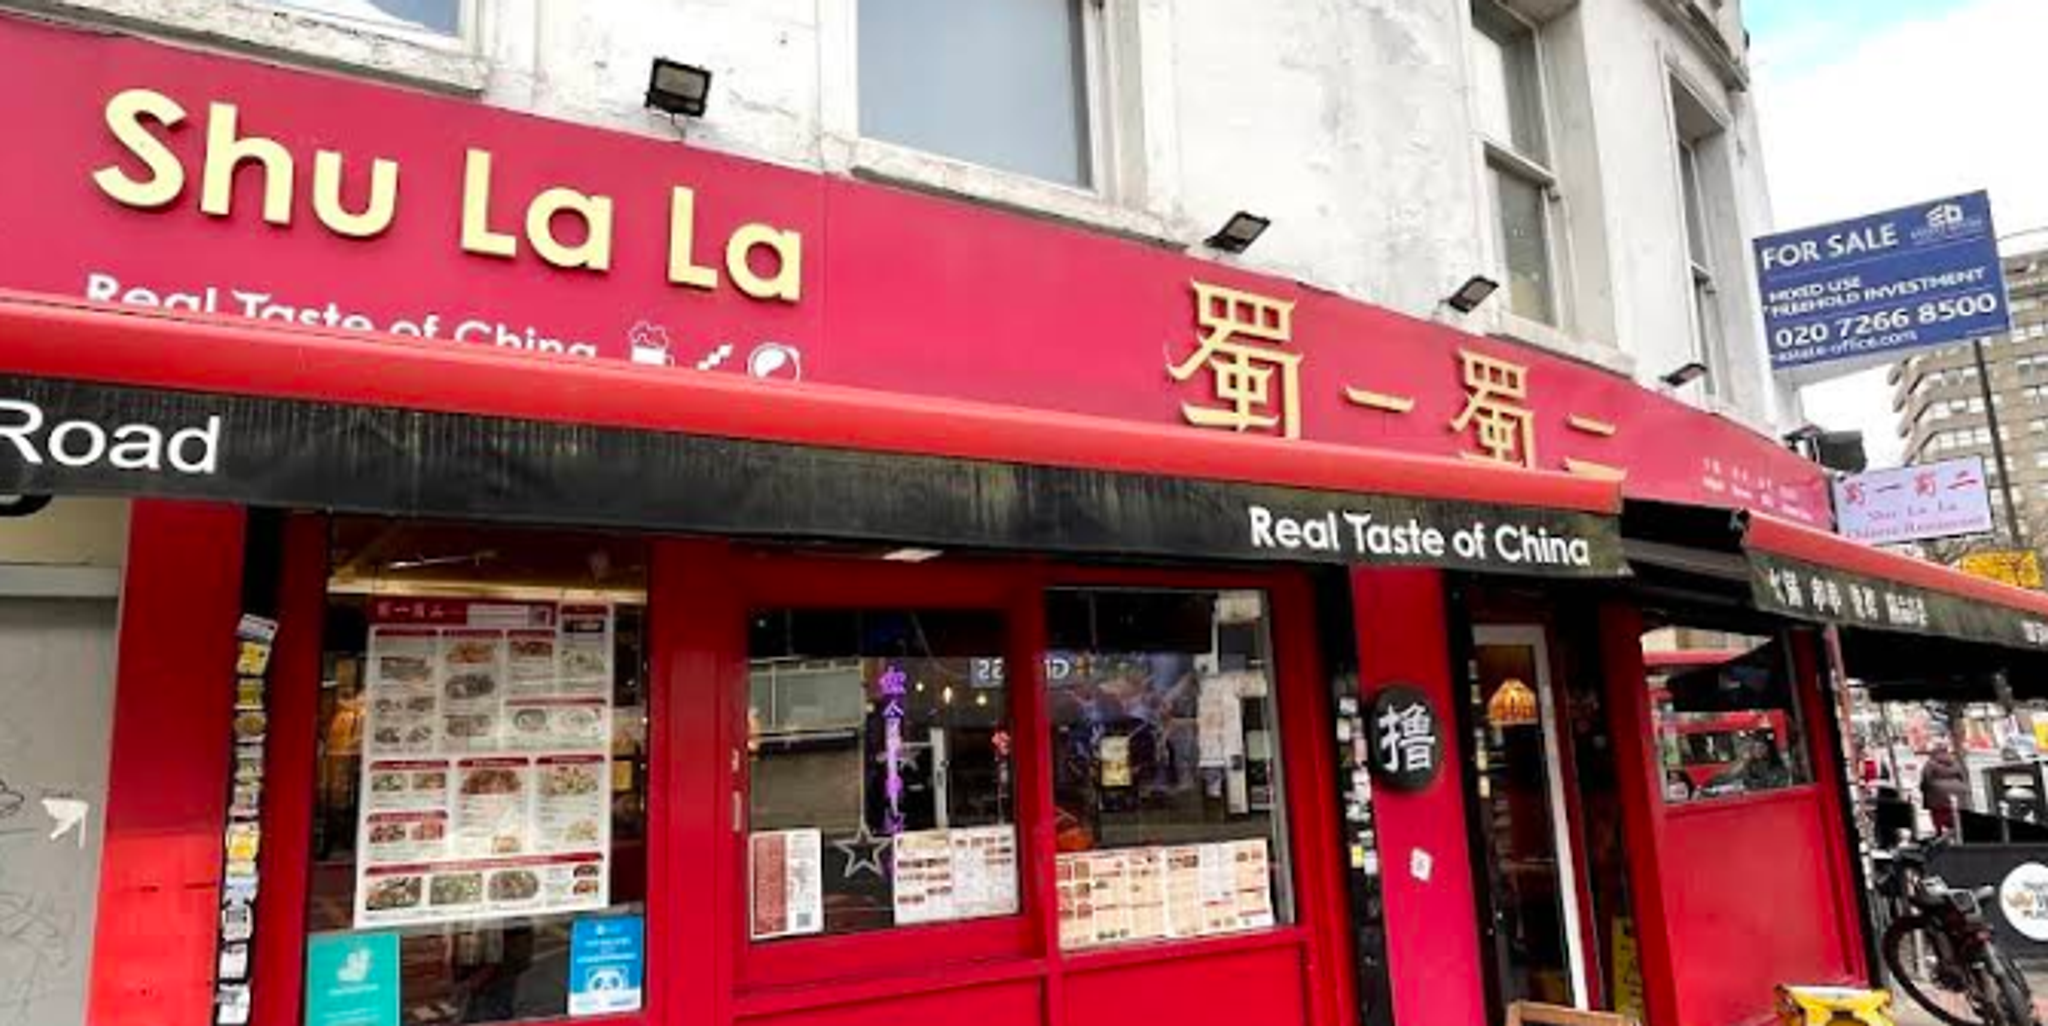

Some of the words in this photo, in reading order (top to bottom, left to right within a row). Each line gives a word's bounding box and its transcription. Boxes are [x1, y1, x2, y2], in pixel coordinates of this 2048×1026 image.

[92, 87, 399, 238] Shu
[460, 149, 613, 272] La
[667, 186, 802, 302] La
[1761, 240, 1821, 271] FOR
[1827, 223, 1899, 258] SALE
[1864, 267, 1986, 301] INVESTMENT
[1776, 322, 1829, 347] 020
[1836, 308, 1910, 336] 7266
[1918, 293, 1997, 324] 8500
[1165, 278, 1627, 482] 蜀一蜀二
[0, 400, 221, 474] Road
[1249, 506, 1341, 550] Real
[1343, 512, 1445, 556] Taste
[1453, 522, 1486, 559] of
[1496, 525, 1591, 567] China
